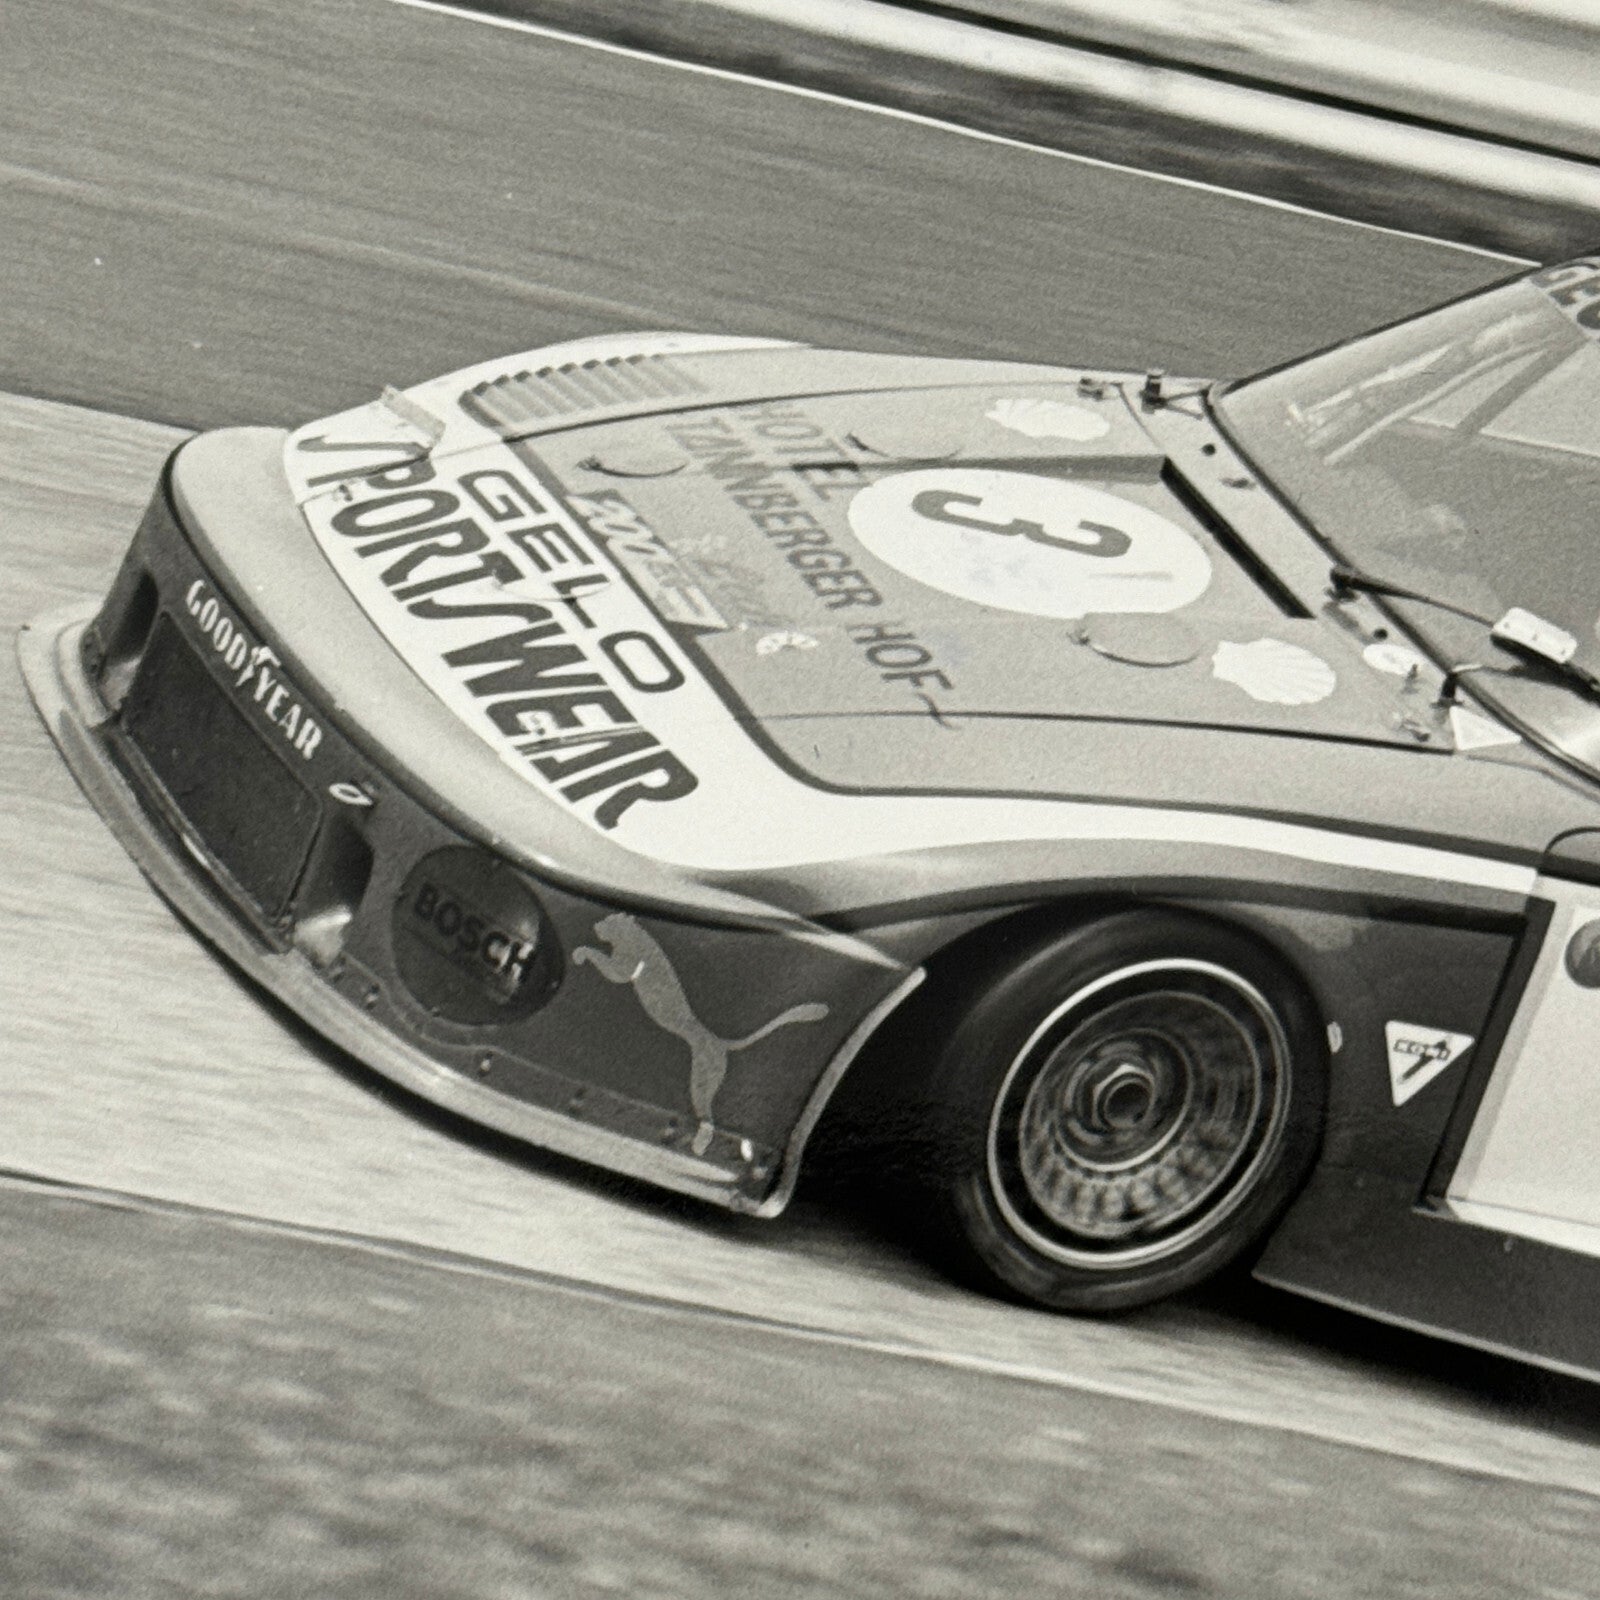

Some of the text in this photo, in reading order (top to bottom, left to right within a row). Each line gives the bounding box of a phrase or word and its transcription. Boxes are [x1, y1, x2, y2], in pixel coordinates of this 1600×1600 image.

[739, 403, 874, 501] HOTEL
[910, 489, 1133, 559] 3
[456, 469, 686, 693] GELO
[185, 579, 323, 761] GOODYEAR
[297, 435, 700, 831] SPORTSWEAR
[846, 621, 955, 691] HOF
[413, 882, 537, 983] BOSCH
